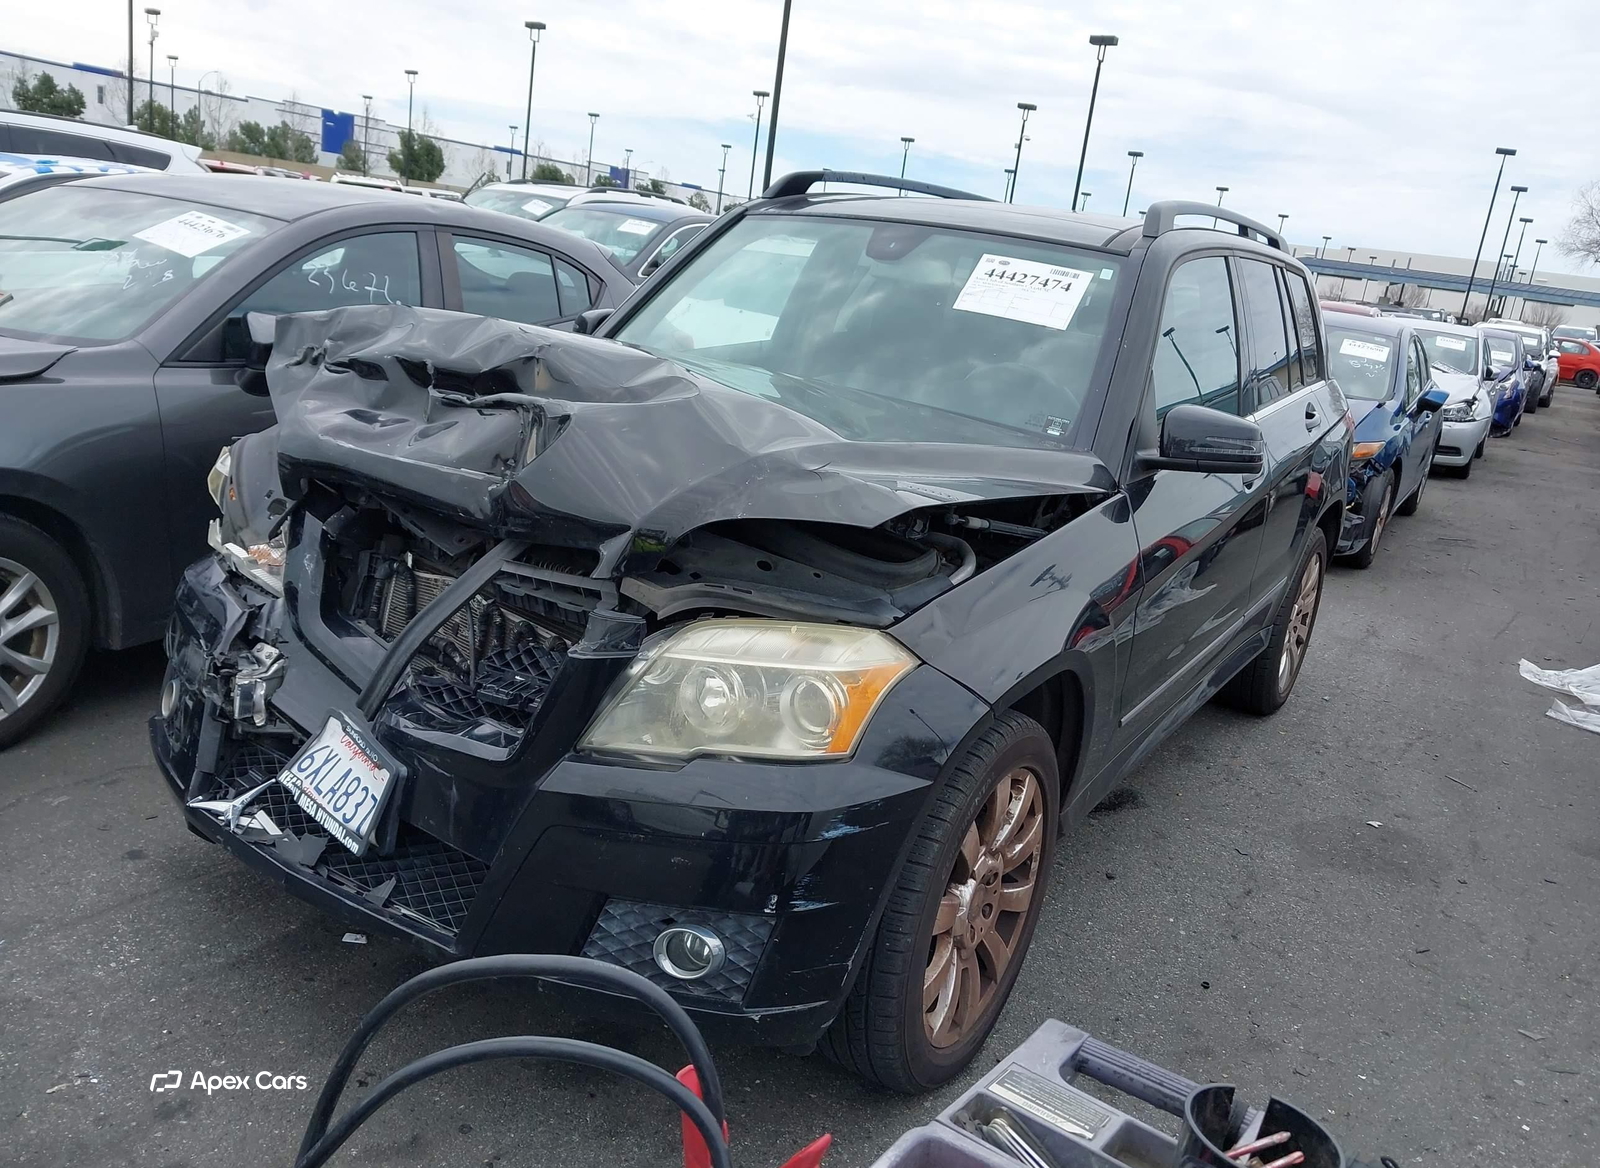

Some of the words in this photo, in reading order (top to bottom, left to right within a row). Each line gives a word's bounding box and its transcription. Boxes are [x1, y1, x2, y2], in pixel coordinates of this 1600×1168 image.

[984, 268, 1073, 292] 44427474
[296, 745, 379, 835] 6XLA837
[297, 791, 317, 816] MESA
